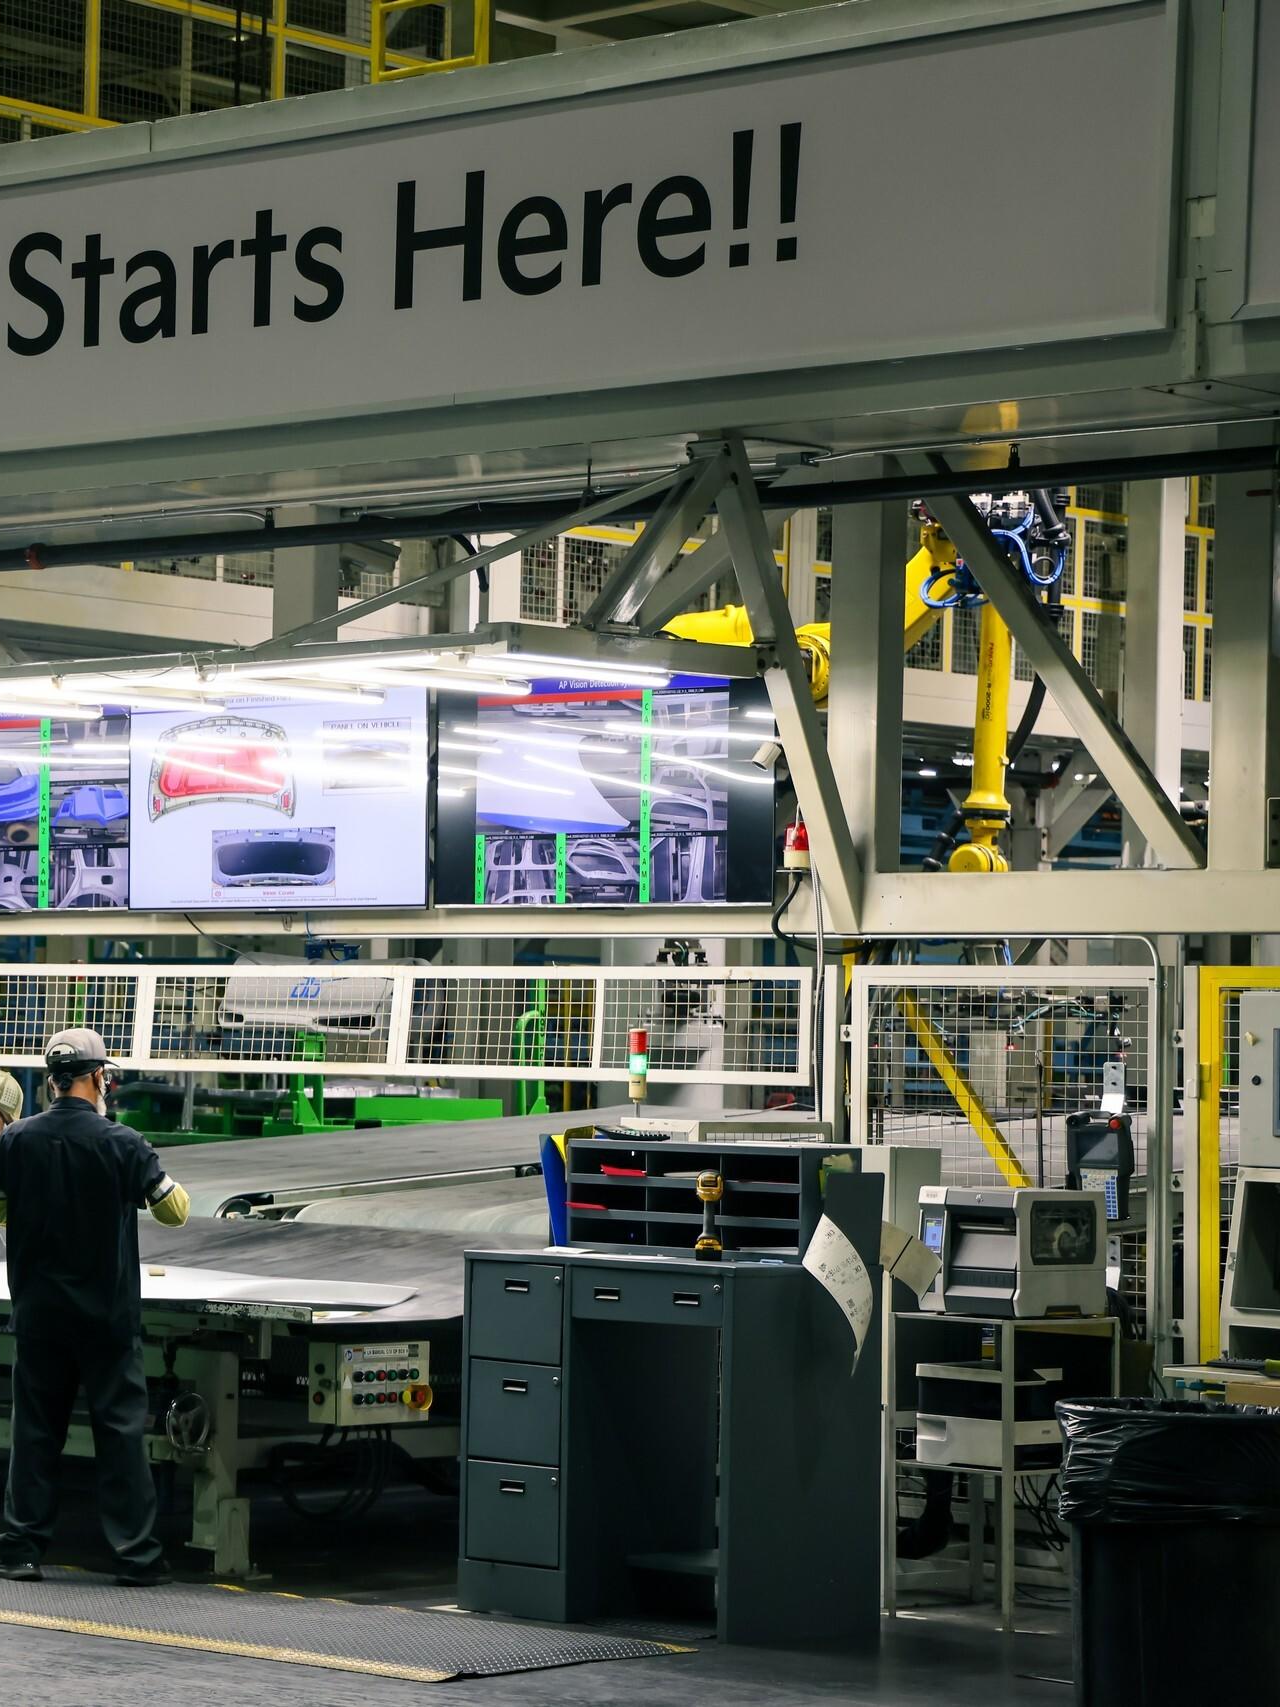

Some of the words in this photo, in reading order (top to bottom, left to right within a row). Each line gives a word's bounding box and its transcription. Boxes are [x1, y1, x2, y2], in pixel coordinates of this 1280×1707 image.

[7, 208, 345, 357] Starts
[393, 121, 803, 311] Here!!
[558, 680, 568, 689] AP
[569, 680, 588, 689] Vision
